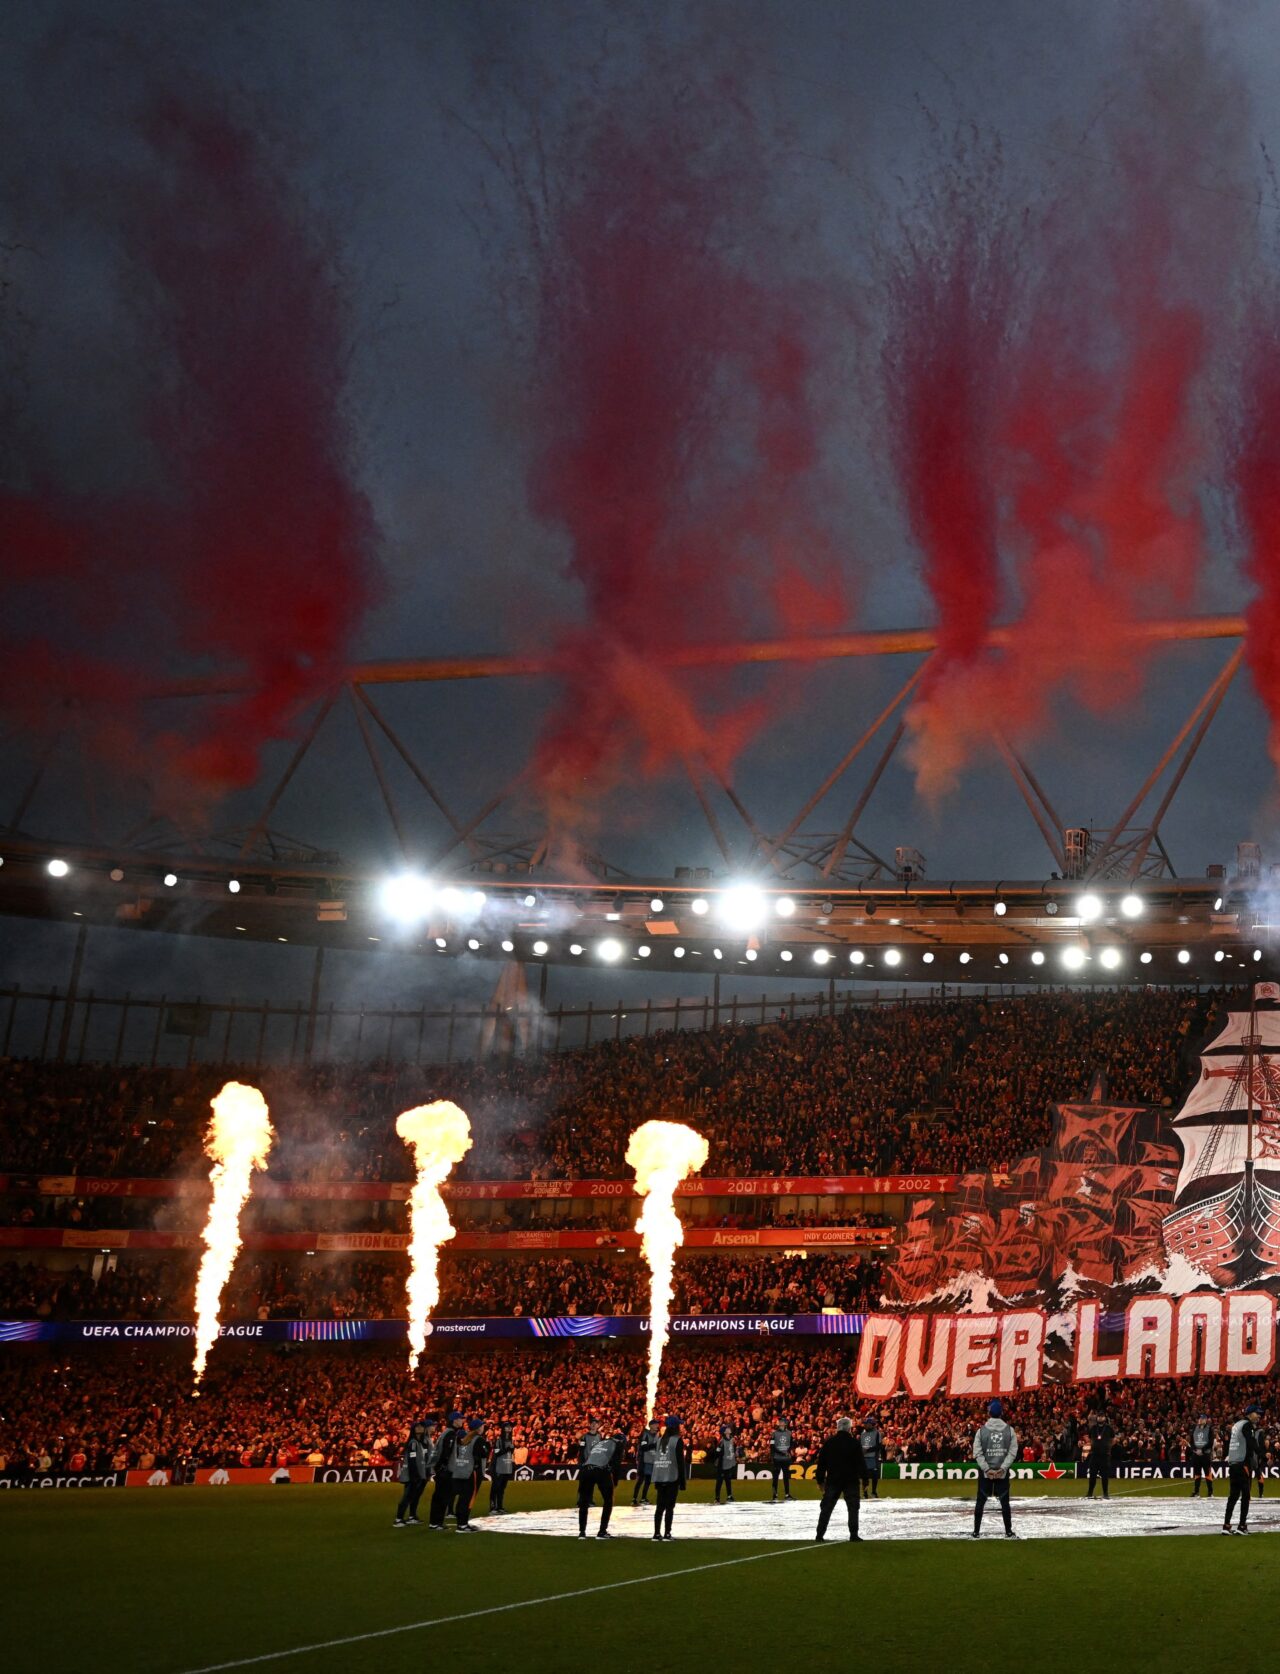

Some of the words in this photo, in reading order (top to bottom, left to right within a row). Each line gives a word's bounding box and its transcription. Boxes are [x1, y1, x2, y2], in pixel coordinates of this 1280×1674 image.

[86, 1182, 120, 1193] 1997
[590, 1184, 624, 1195] 2000
[727, 1182, 757, 1193] 2001
[898, 1180, 931, 1190] 2002
[713, 1231, 760, 1245] Arsenal
[804, 1232, 821, 1241] INDY
[822, 1232, 854, 1241] GOONERS
[436, 1323, 486, 1332] mastercard
[673, 1320, 745, 1331] CHAMPIONS
[748, 1319, 795, 1330] LEAGUE
[82, 1326, 120, 1336] UEFA
[218, 1326, 263, 1336] EAGUE
[853, 1307, 1047, 1399] OVER
[1073, 1290, 1278, 1383] LAND
[323, 1468, 394, 1483] QATAR
[1116, 1467, 1163, 1479] UEFA
